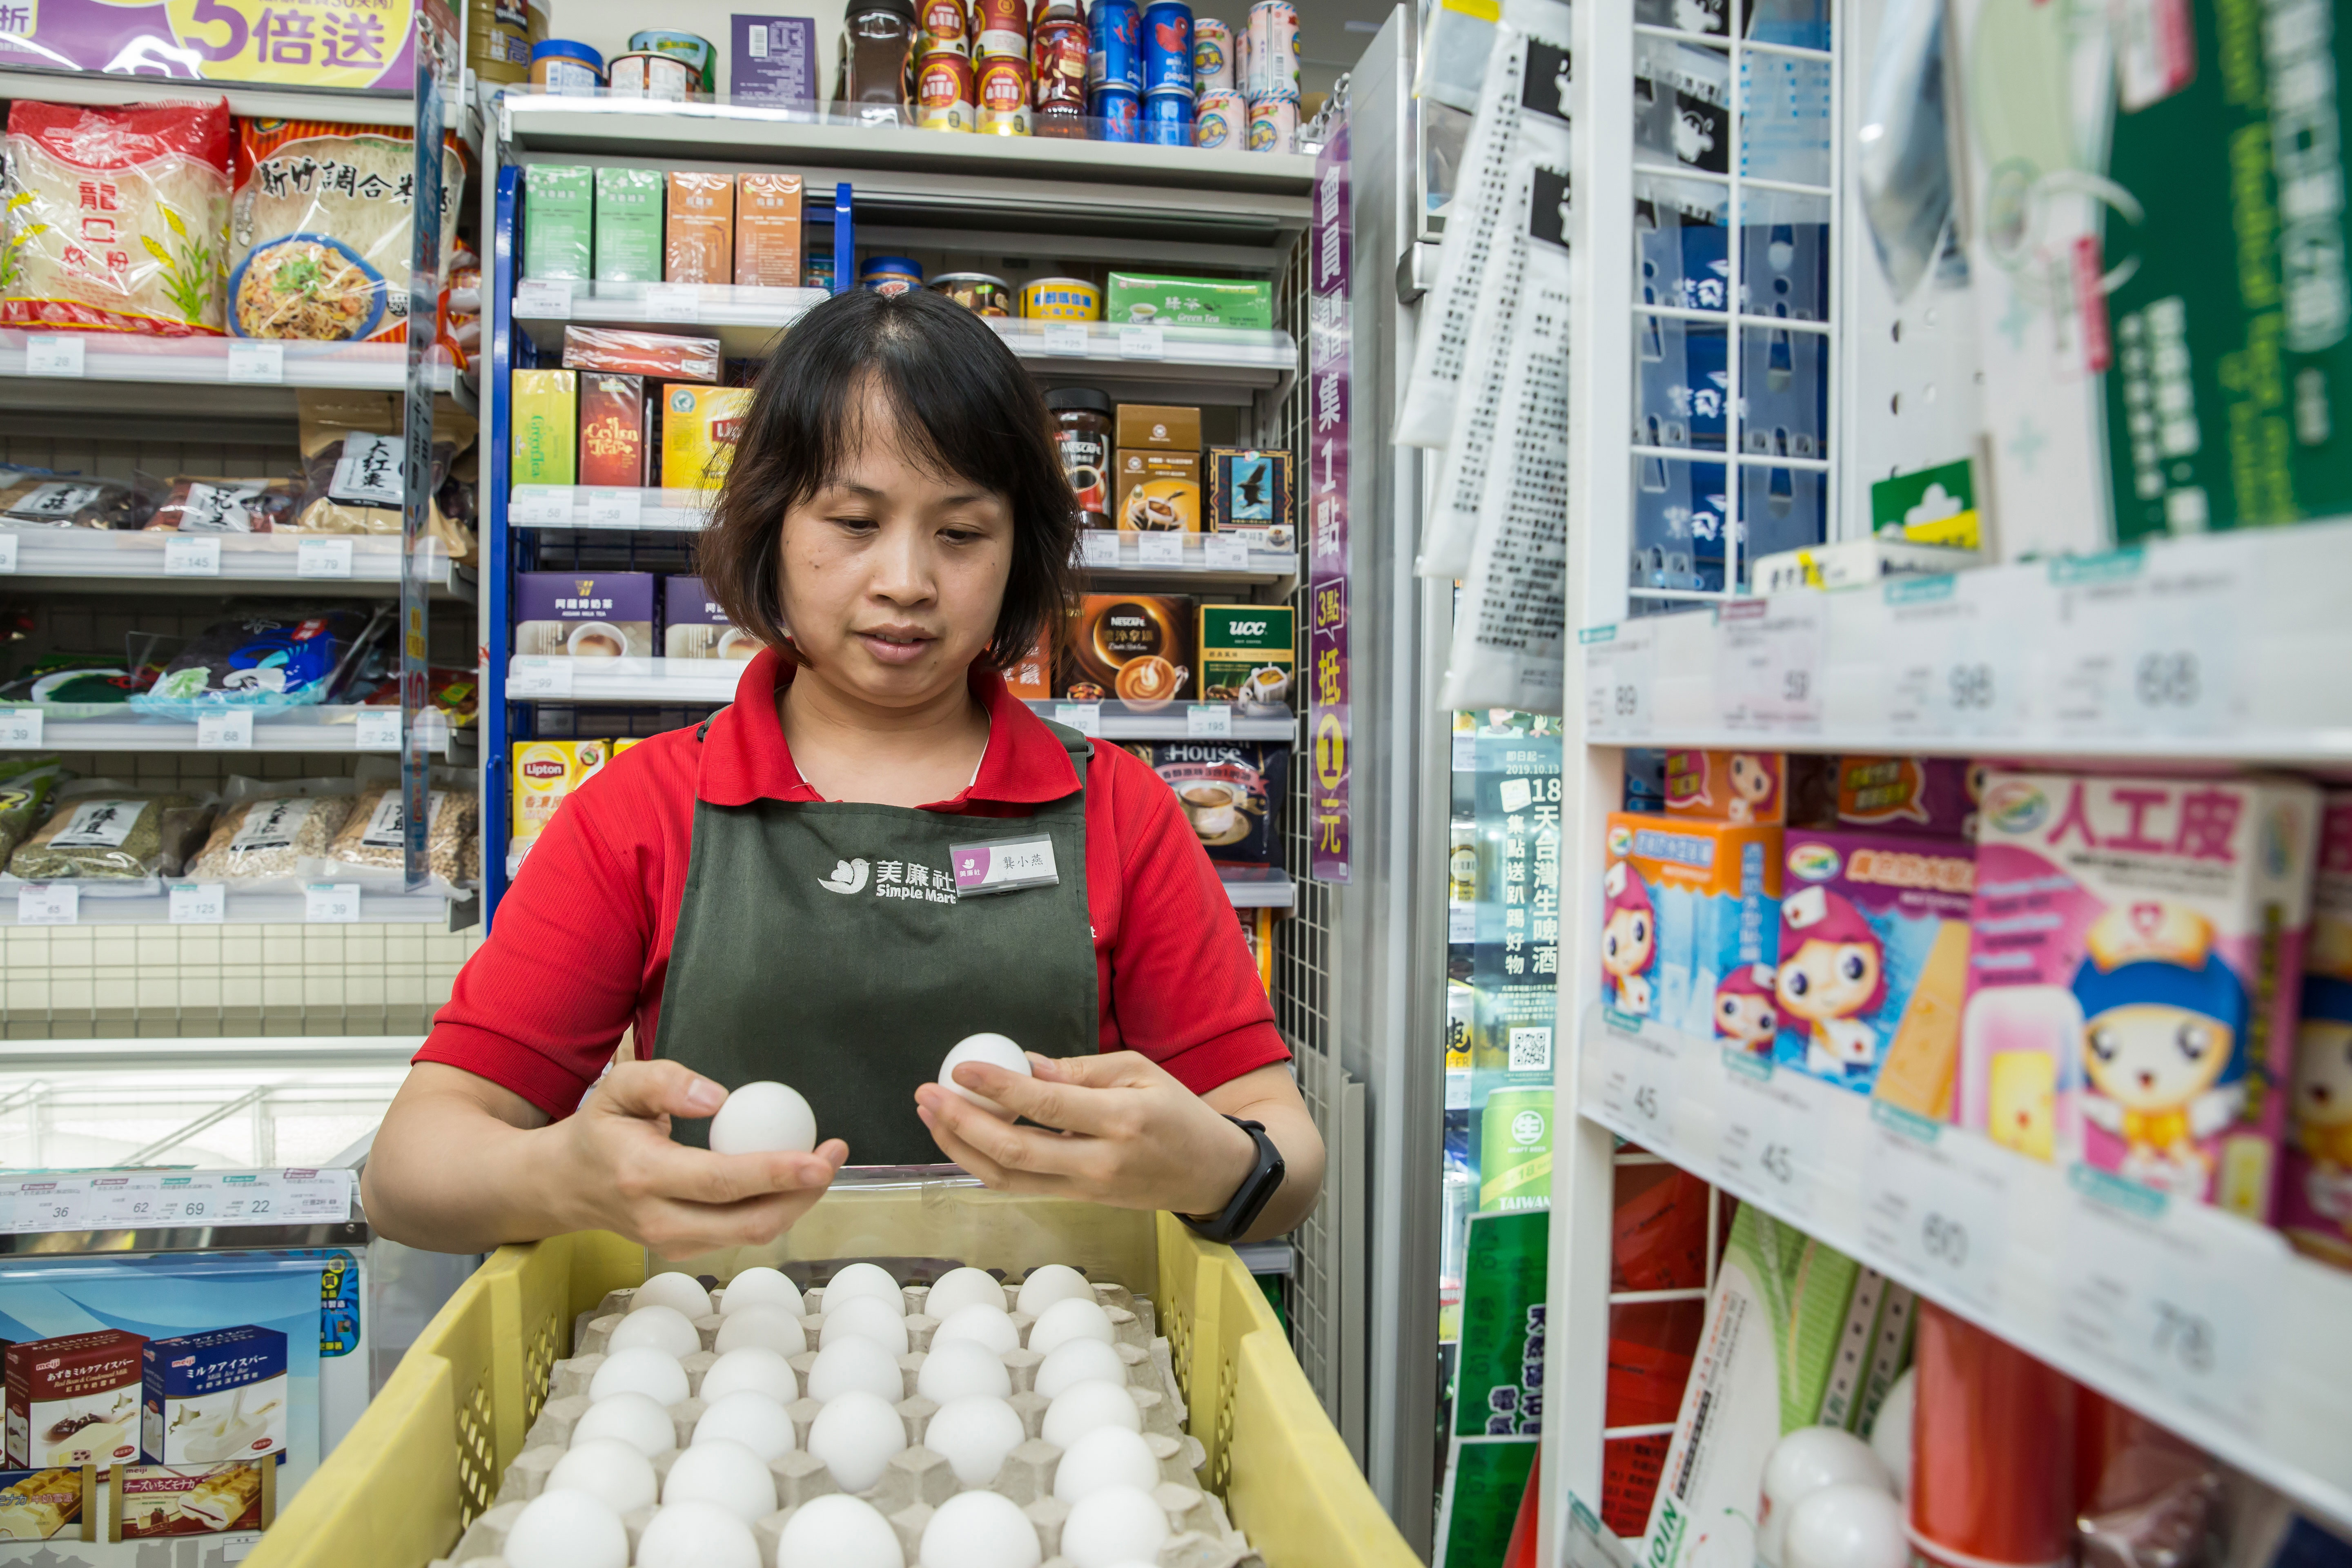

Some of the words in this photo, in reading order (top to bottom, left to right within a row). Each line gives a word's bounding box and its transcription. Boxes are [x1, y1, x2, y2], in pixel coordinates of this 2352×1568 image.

[259, 158, 451, 212] 新竹調合米
[78, 181, 118, 243] 龍口
[584, 417, 638, 442] Ceylon
[188, 557, 209, 568] 145
[1317, 588, 1340, 627] 3點
[13, 729, 28, 740] 39
[223, 731, 238, 742] 68
[1170, 743, 1241, 762] House
[527, 764, 562, 777] Lipton
[1506, 764, 1560, 775] 2019.10.13
[2046, 779, 2245, 863] 人工皮
[1002, 853, 1043, 870] 龔小燕
[876, 860, 956, 893] 美廉社
[960, 868, 981, 877] 美廉社
[876, 884, 924, 900] Simple
[925, 888, 957, 904] Mart
[53, 1207, 69, 1218] 36
[134, 1202, 149, 1213] 62
[186, 1203, 204, 1215] 69
[252, 1200, 270, 1213] 22
[36, 1358, 60, 1372] meiji
[172, 1356, 196, 1368] meiji
[186, 1356, 268, 1379] ミルクアイスバー
[47, 1361, 134, 1382] あずきミルクアイスバー
[126, 1466, 148, 1474] meiji
